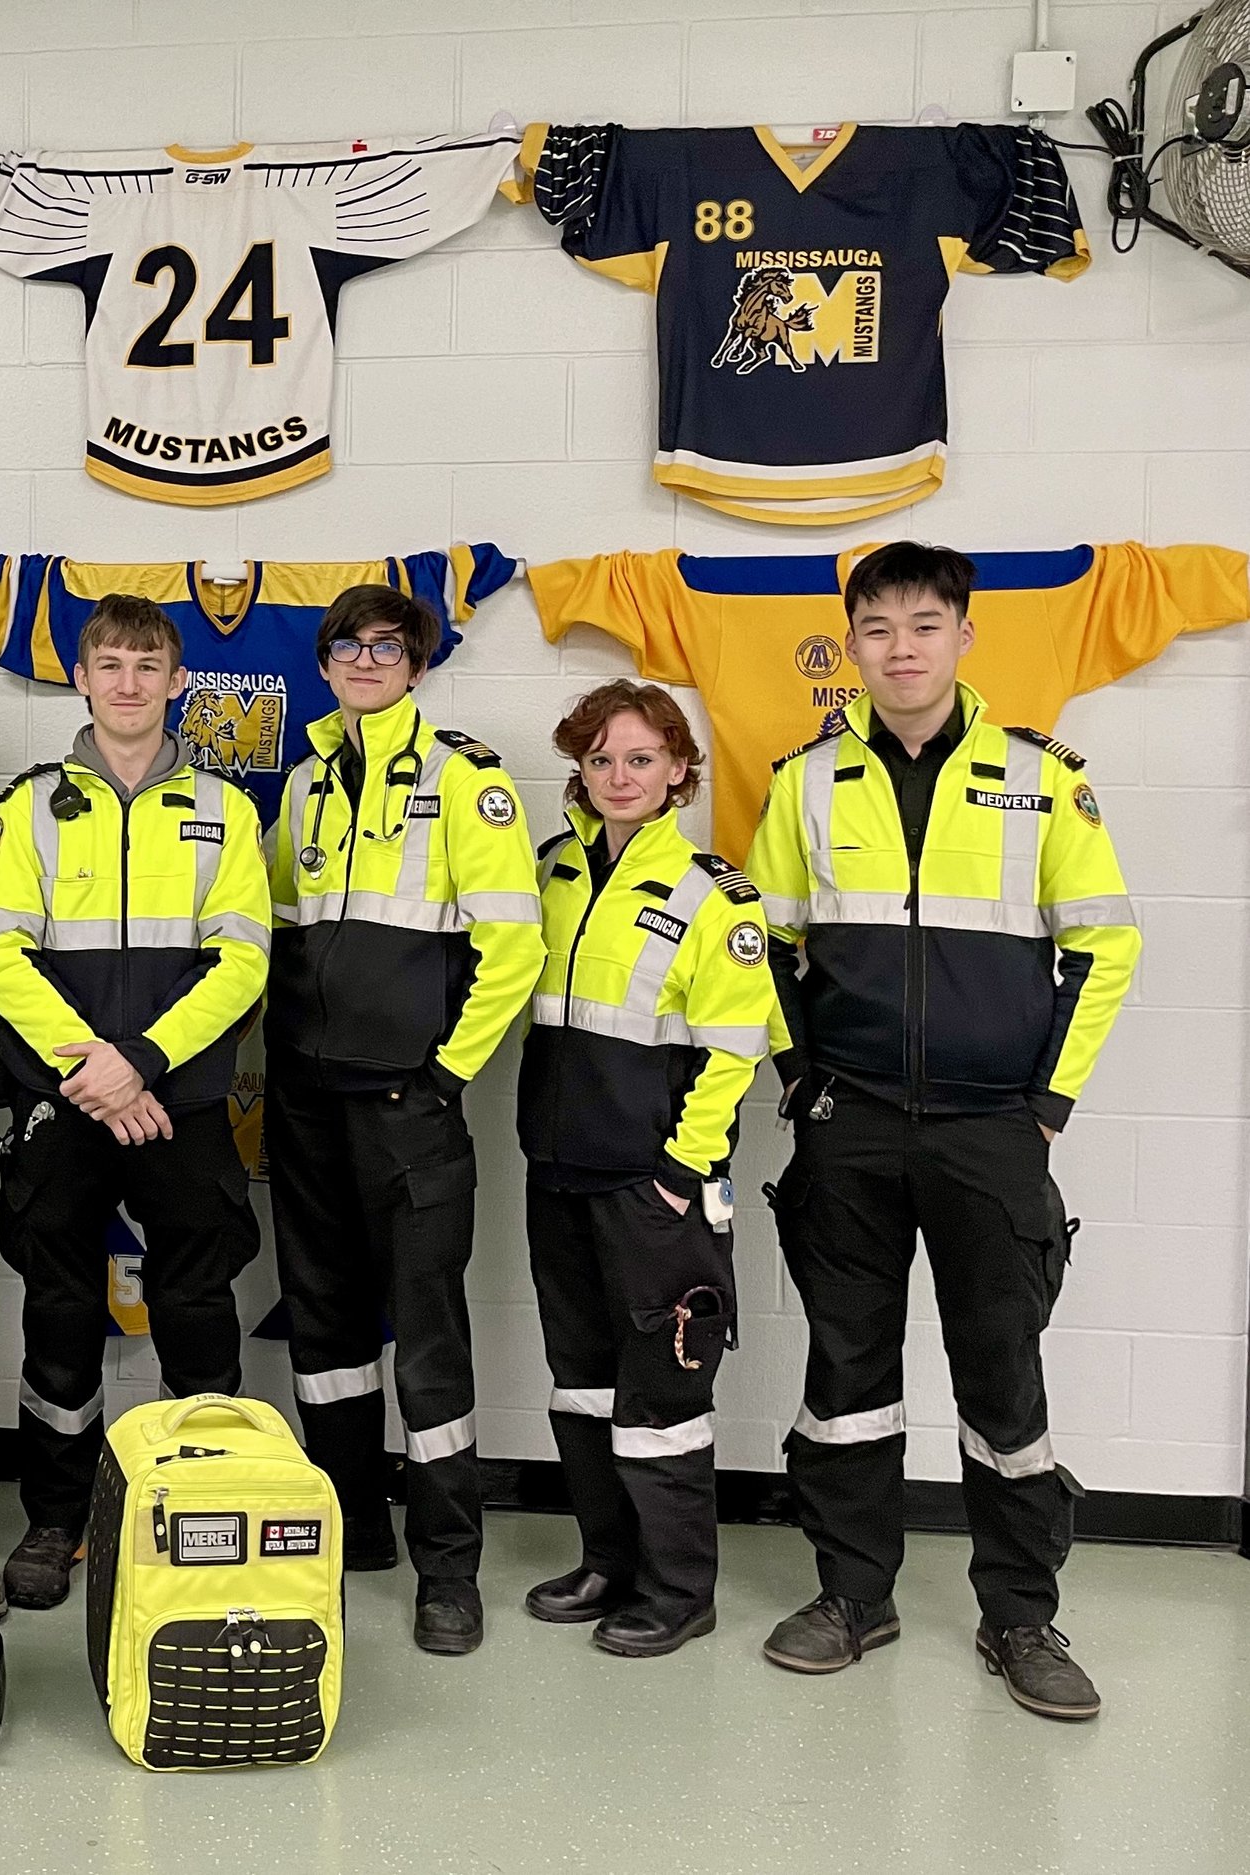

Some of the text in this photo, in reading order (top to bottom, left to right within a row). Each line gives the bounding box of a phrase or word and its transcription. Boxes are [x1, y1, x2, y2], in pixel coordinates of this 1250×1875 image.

[694, 199, 755, 243] 88
[735, 249, 883, 268] MISSISSAUGA
[124, 240, 292, 369] 24
[853, 275, 876, 358] MUSTANGS
[103, 416, 308, 464] MUSTANGS
[257, 699, 276, 765] MUSTANGS
[976, 792, 1042, 810] MEDVENT
[182, 825, 222, 840] MEDICAL
[638, 910, 683, 940] MEDICAL
[183, 1532, 236, 1546] MERET
[311, 1526, 317, 1537] 2
